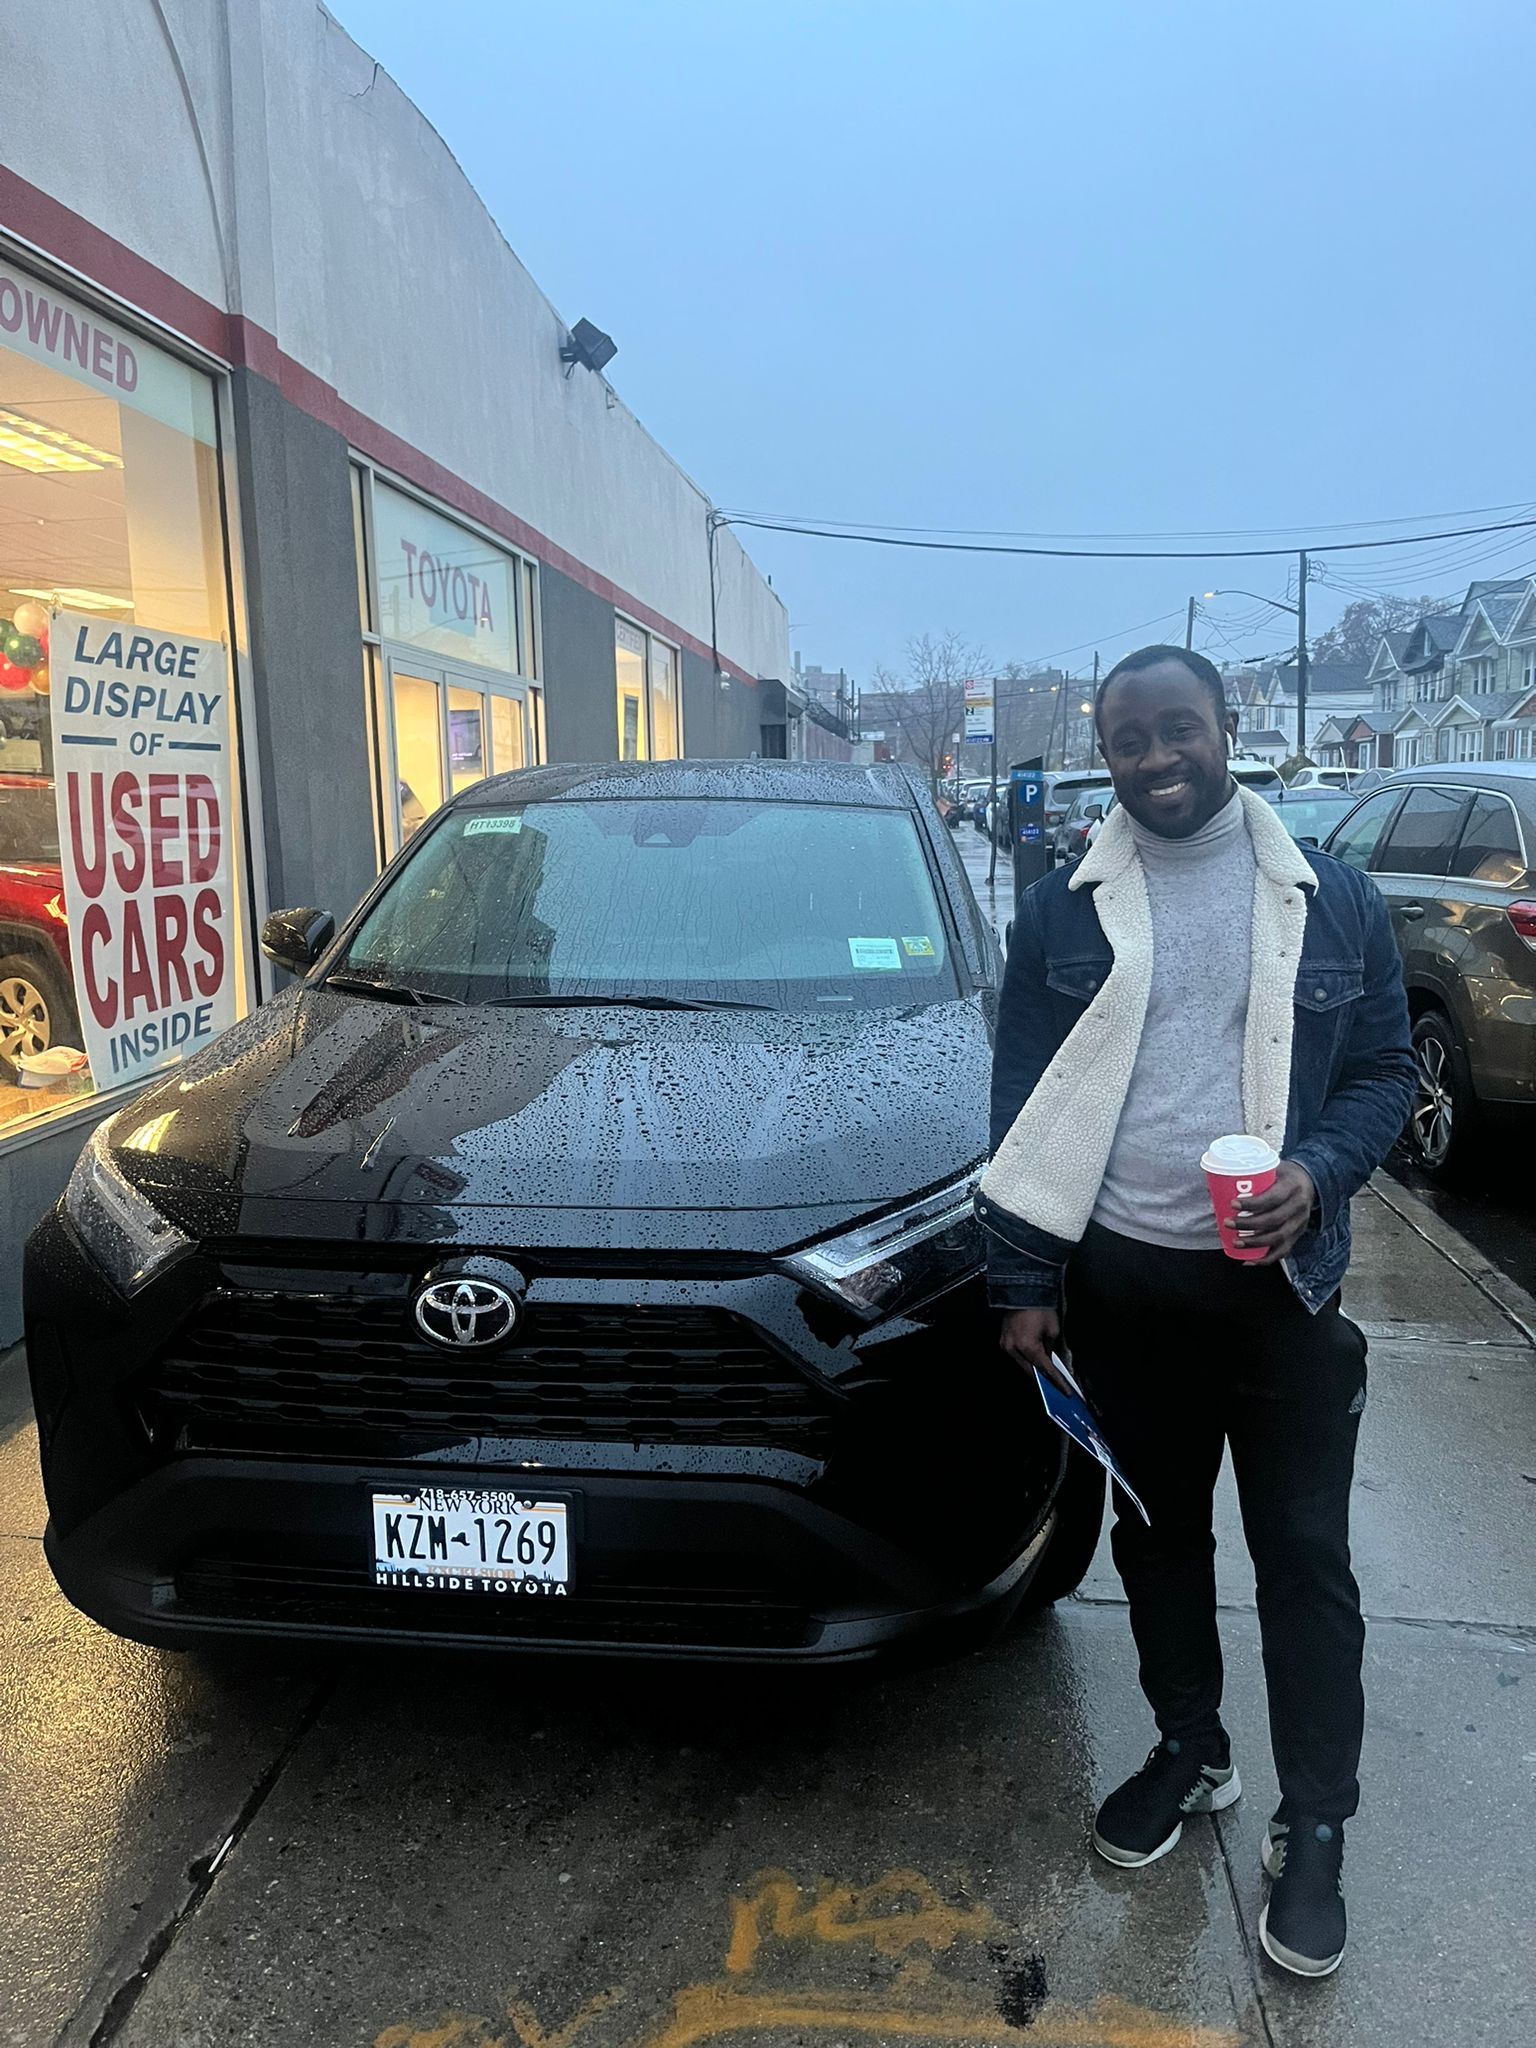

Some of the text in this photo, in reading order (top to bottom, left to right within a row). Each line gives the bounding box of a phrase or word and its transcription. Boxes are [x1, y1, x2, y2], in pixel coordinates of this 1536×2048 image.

[0, 277, 138, 393] OWNED
[400, 538, 494, 633] TOYOTA
[74, 625, 200, 679] LARGE
[64, 676, 222, 725] DISPLAY
[129, 731, 165, 756] OF
[1025, 784, 1038, 803] P
[67, 770, 221, 899] USED
[82, 888, 224, 1030] CARS
[109, 1001, 214, 1074] INSIDE
[419, 1487, 516, 1501] 718-657-5500
[419, 1498, 520, 1515] NEW YORK
[376, 1573, 568, 1596] HILLSIDE TOYOTA
